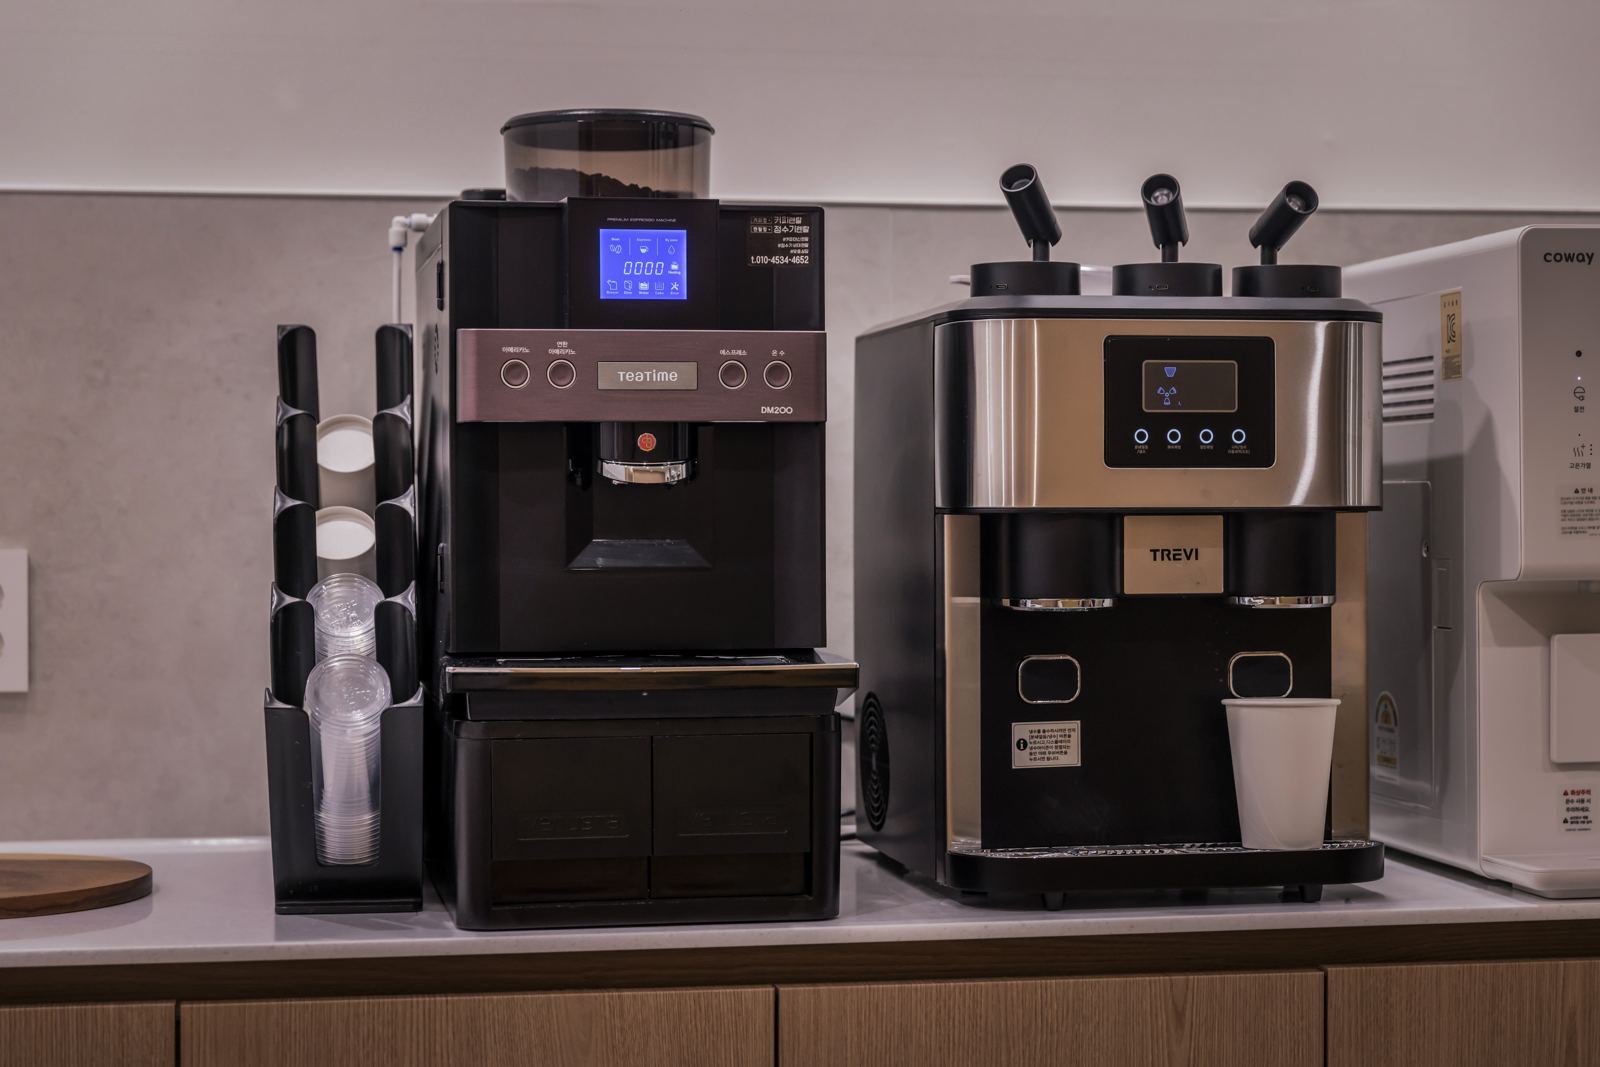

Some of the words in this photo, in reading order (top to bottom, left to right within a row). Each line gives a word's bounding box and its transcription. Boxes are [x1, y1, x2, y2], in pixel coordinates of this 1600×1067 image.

[774, 216, 802, 225] 커피렌탈
[773, 225, 810, 234] 정수기렌탈
[751, 255, 809, 264] t.010-4534-4652
[1543, 252, 1595, 265] coway
[623, 261, 664, 275] 0000
[761, 406, 793, 415] DM200
[1149, 548, 1199, 561] TREVI
